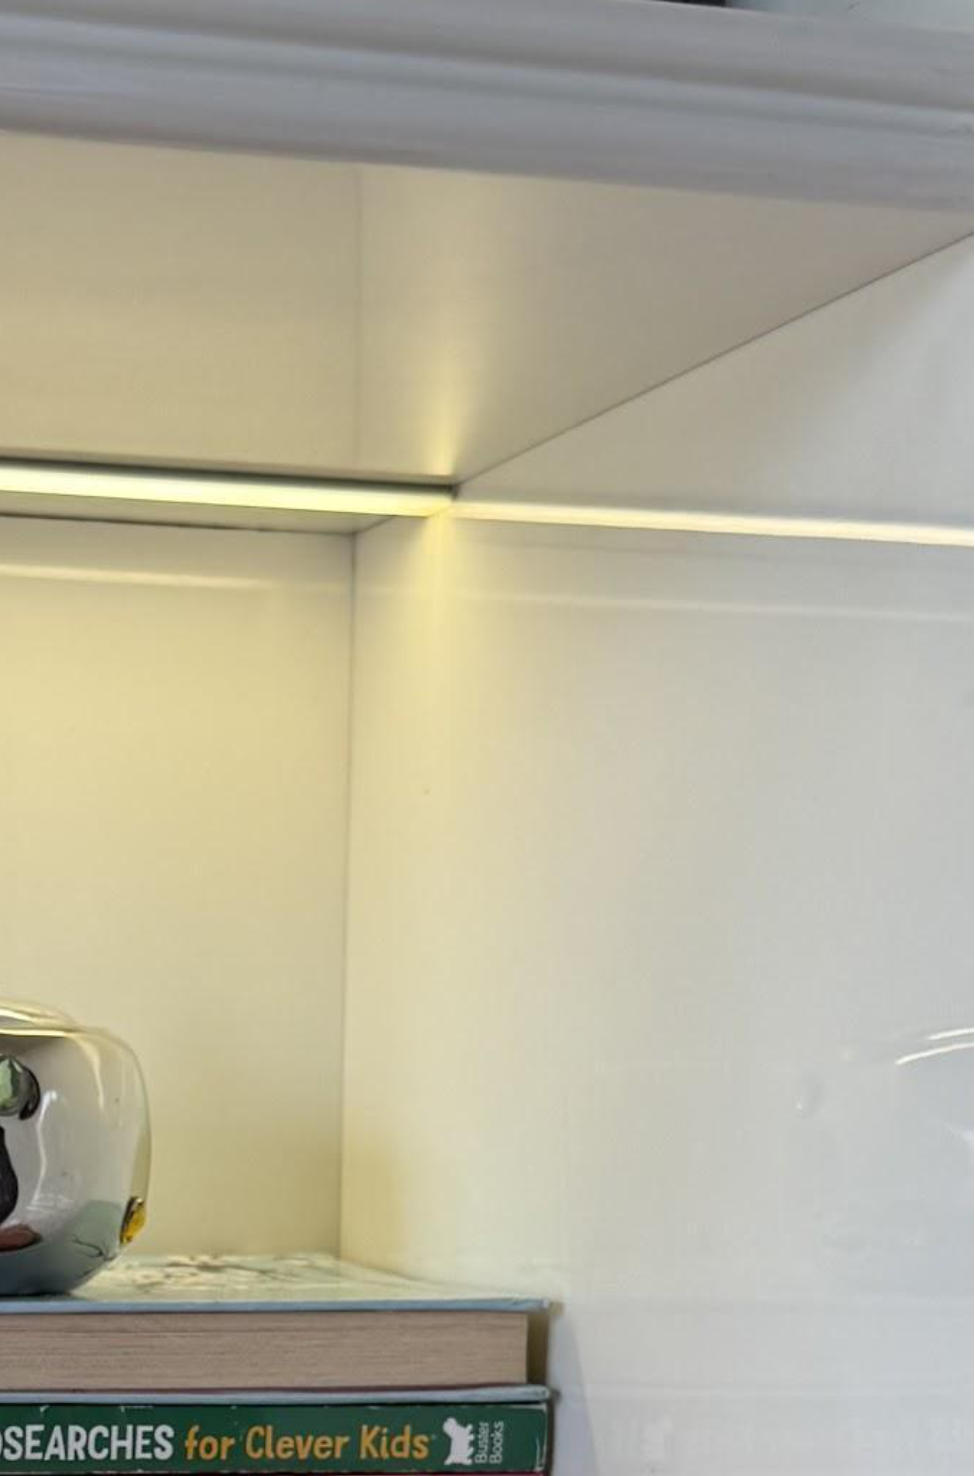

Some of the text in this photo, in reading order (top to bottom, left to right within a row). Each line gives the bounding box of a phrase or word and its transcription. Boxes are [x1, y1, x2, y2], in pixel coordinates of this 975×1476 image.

[184, 1424, 236, 1462] for
[245, 1425, 349, 1461] Clever
[359, 1424, 430, 1460] Kids
[474, 1421, 489, 1464] Buster
[489, 1420, 505, 1464] Books
